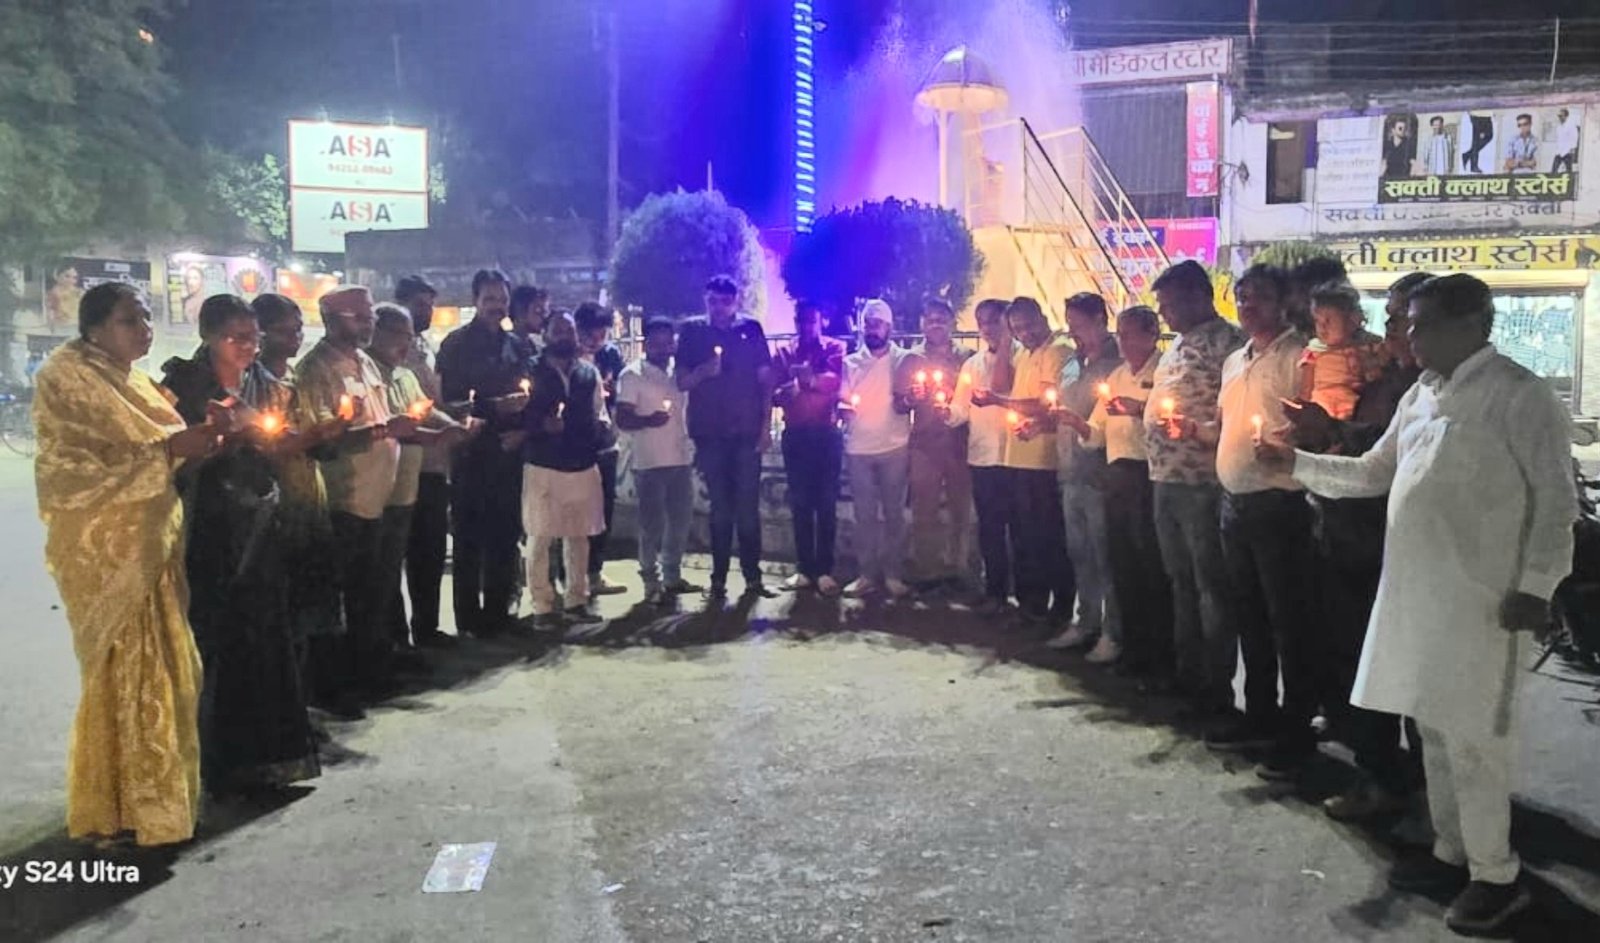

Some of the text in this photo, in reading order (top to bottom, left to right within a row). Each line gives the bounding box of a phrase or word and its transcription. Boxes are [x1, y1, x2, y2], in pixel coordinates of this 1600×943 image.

[328, 135, 392, 158] ASA
[1384, 177, 1441, 198] सक्ती
[1445, 177, 1510, 197] क्लाथ
[1514, 172, 1570, 195] स्टोर्स
[329, 200, 392, 223] ASA
[1387, 243, 1478, 264] क्लाथ
[1490, 239, 1569, 263] स्टोर्स
